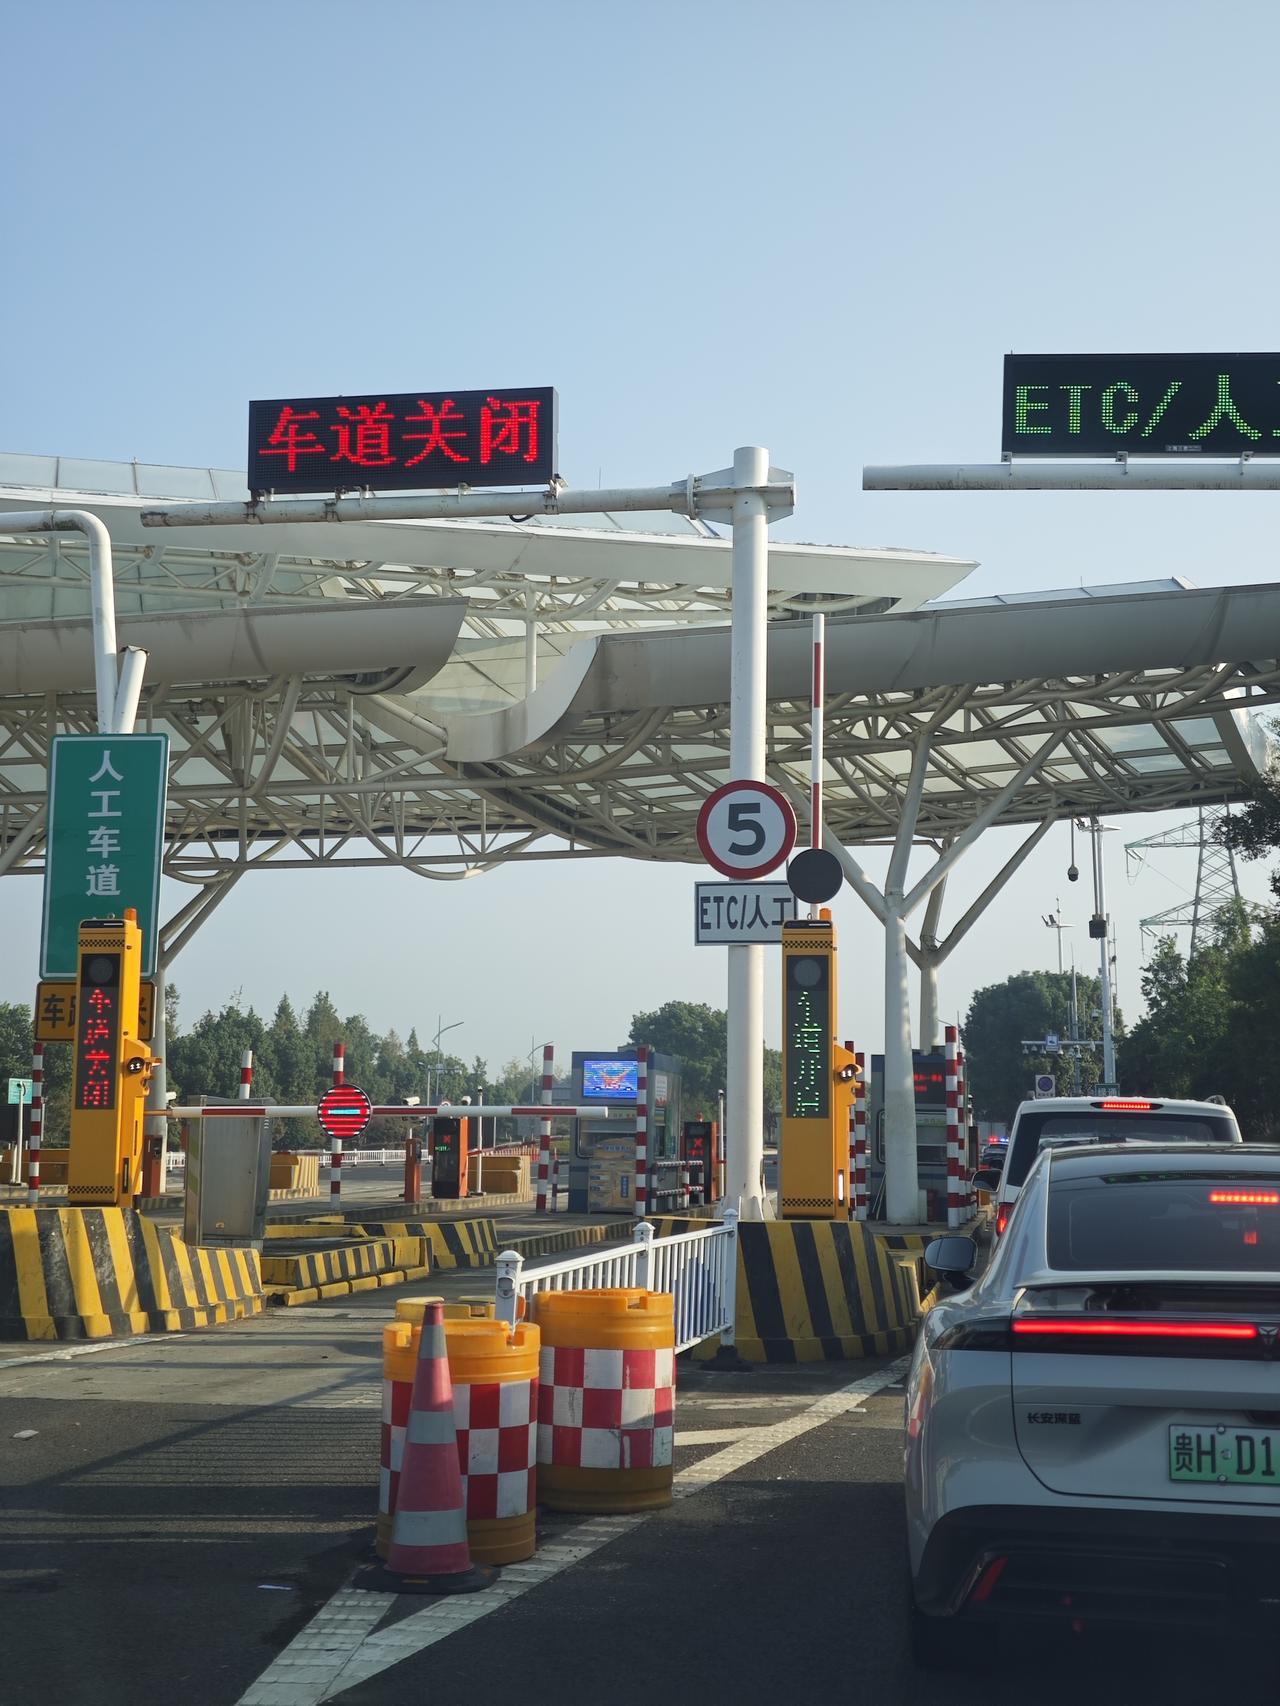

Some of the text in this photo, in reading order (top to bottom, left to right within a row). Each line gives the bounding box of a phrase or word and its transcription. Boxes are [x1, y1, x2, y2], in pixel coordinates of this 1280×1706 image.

[258, 396, 540, 473] 车道关闭
[1015, 374, 1280, 440] ETC/人
[86, 751, 124, 896] 人工车道
[727, 802, 766, 856] 5
[700, 895, 792, 930] ETC/人工
